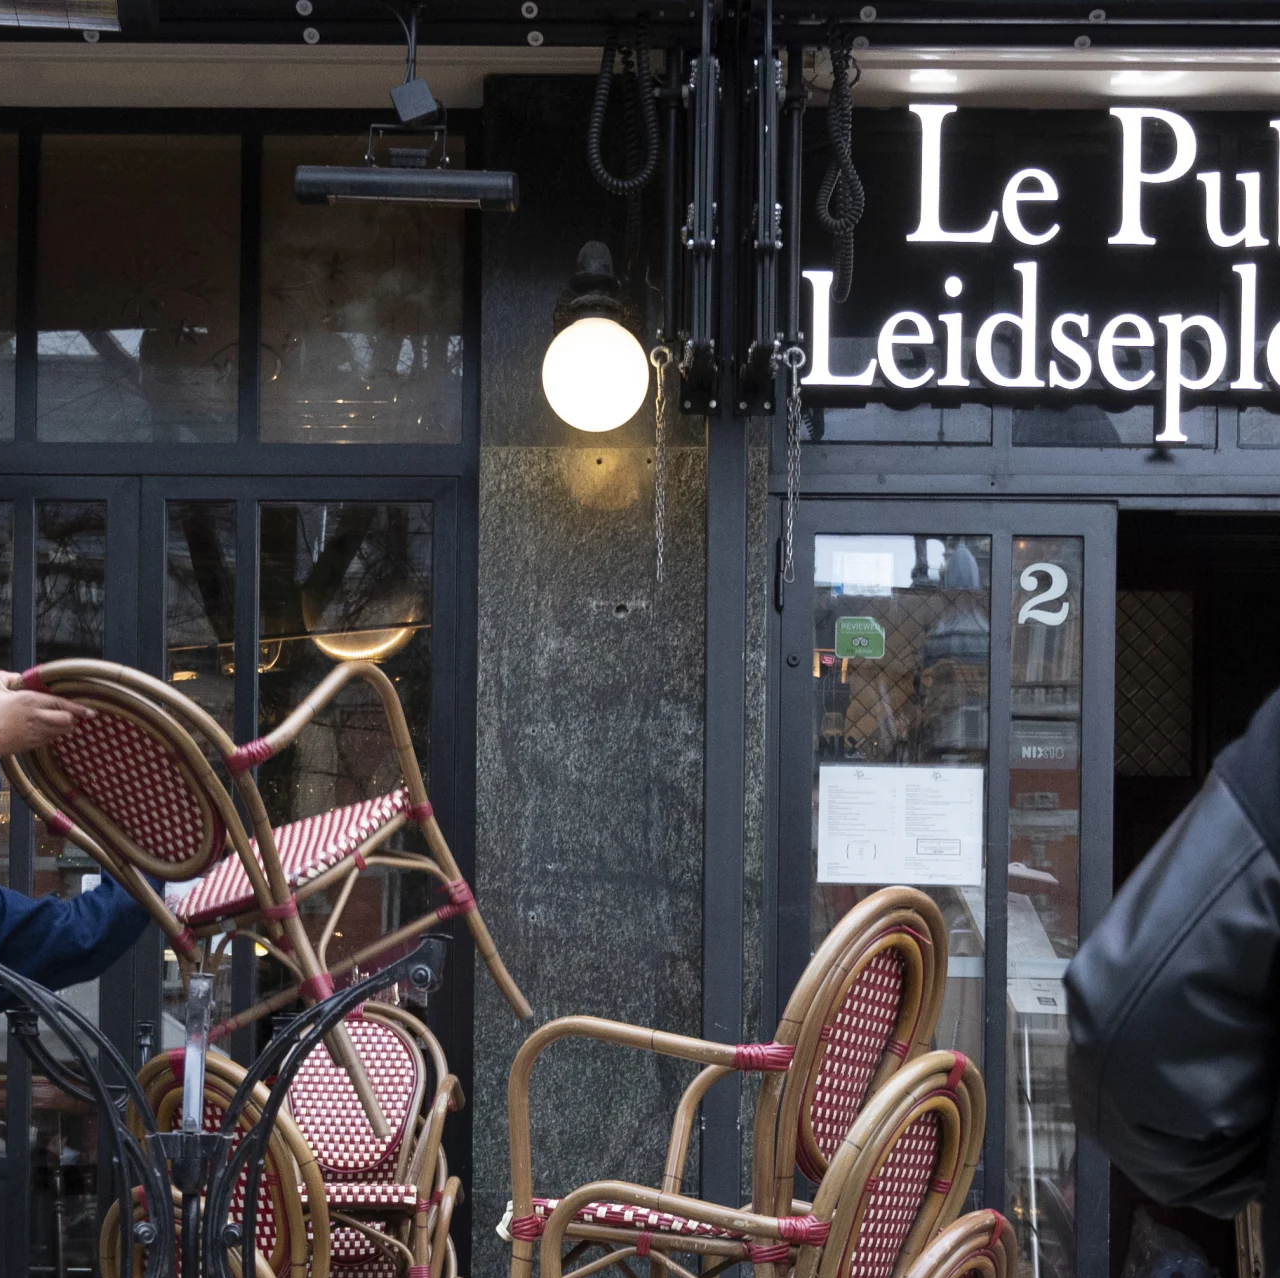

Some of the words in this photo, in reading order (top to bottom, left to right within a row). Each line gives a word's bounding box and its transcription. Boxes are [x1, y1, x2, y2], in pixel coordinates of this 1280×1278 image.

[906, 104, 1059, 245] Le
[1018, 563, 1069, 625] 2
[1021, 746, 1065, 759] NIX18
